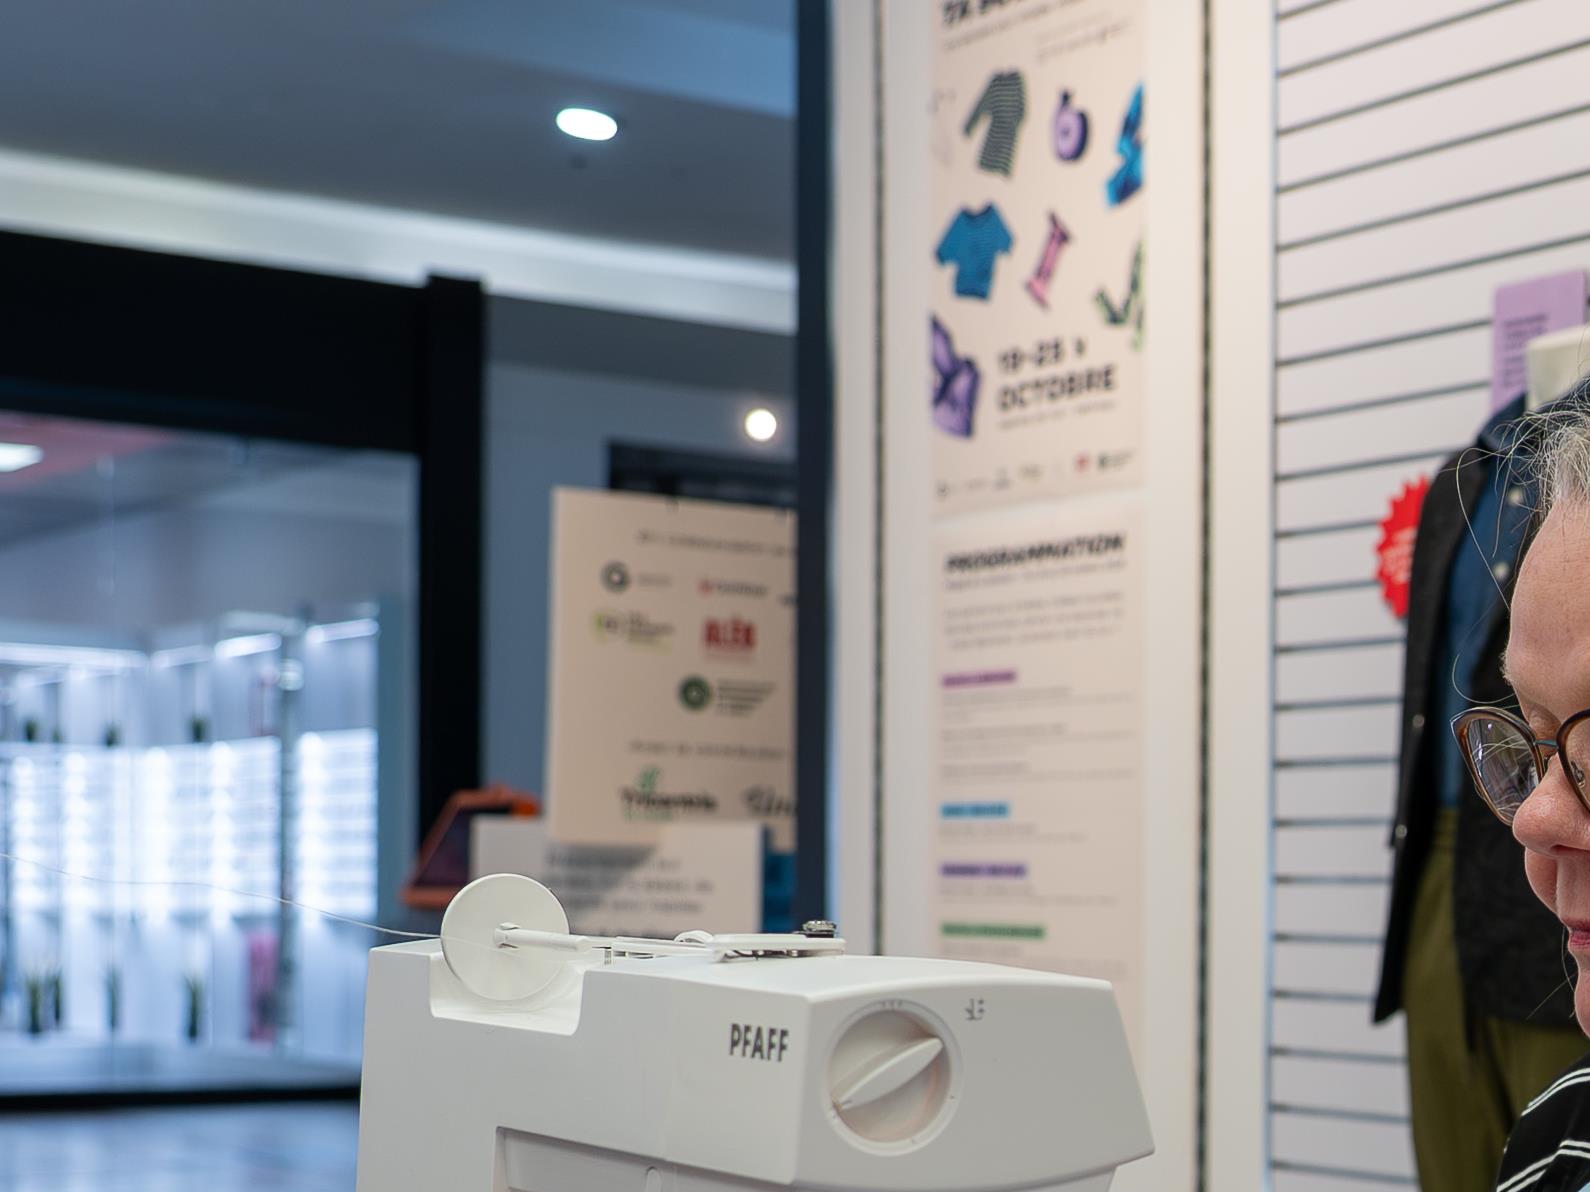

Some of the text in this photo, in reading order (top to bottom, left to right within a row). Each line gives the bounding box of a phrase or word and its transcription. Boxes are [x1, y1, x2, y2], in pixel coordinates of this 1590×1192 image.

[998, 365, 1122, 412] OCTOBRE
[945, 531, 1125, 571] PROGRAMMATION
[729, 1022, 789, 1063] PFAFF
